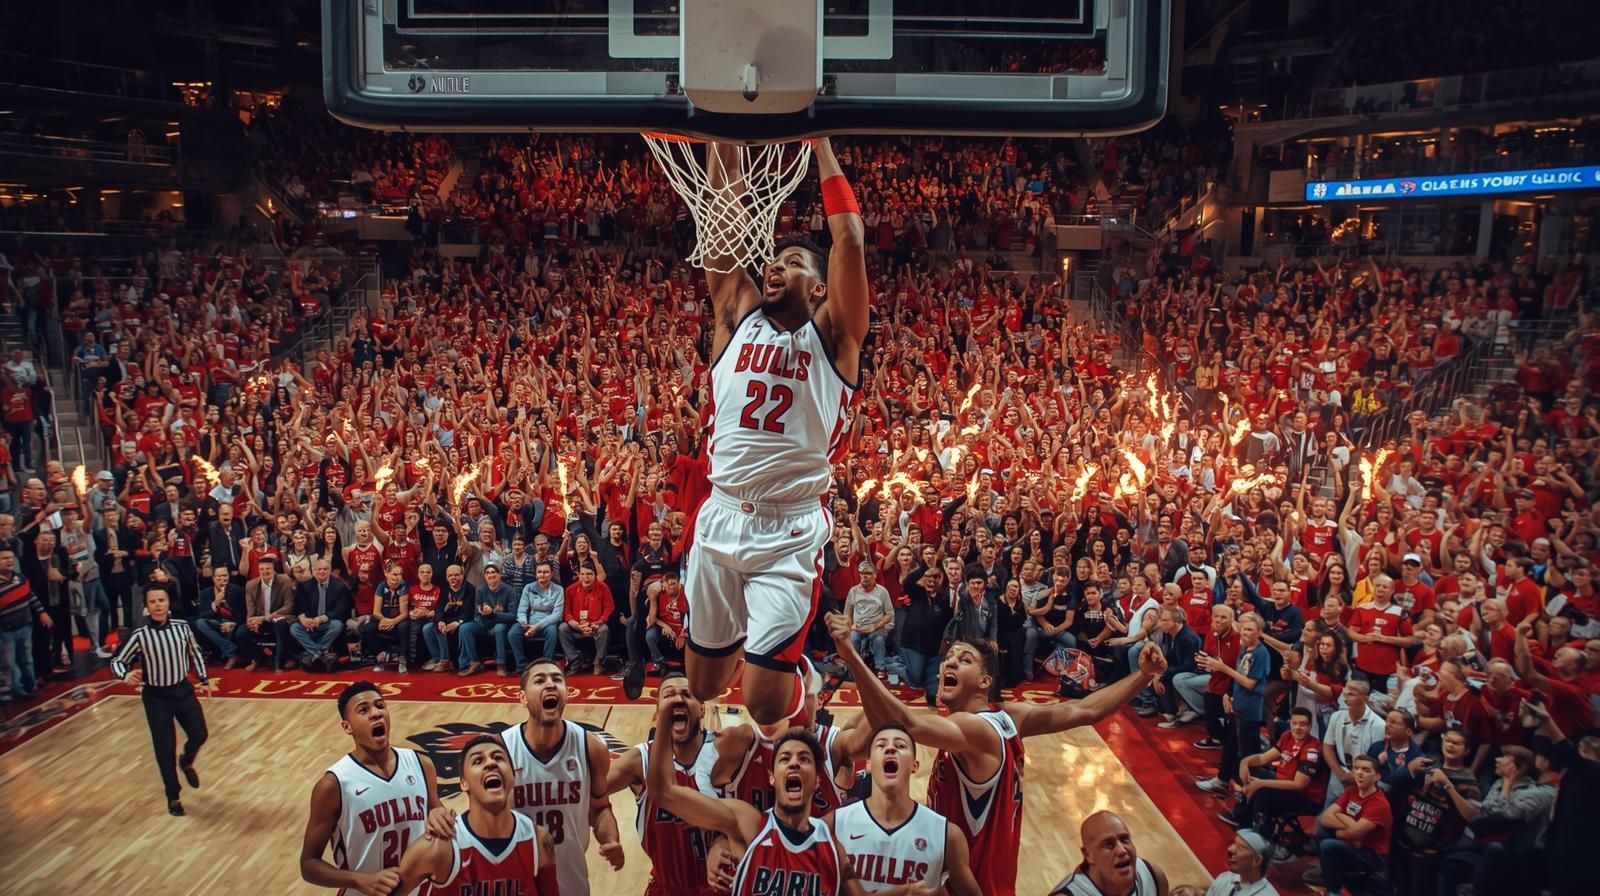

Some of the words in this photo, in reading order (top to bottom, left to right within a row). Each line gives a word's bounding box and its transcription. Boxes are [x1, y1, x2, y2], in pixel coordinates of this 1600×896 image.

[734, 343, 812, 382] BULLS
[739, 379, 794, 435] 22
[513, 780, 582, 809] BULLS
[358, 795, 425, 834] BULLS
